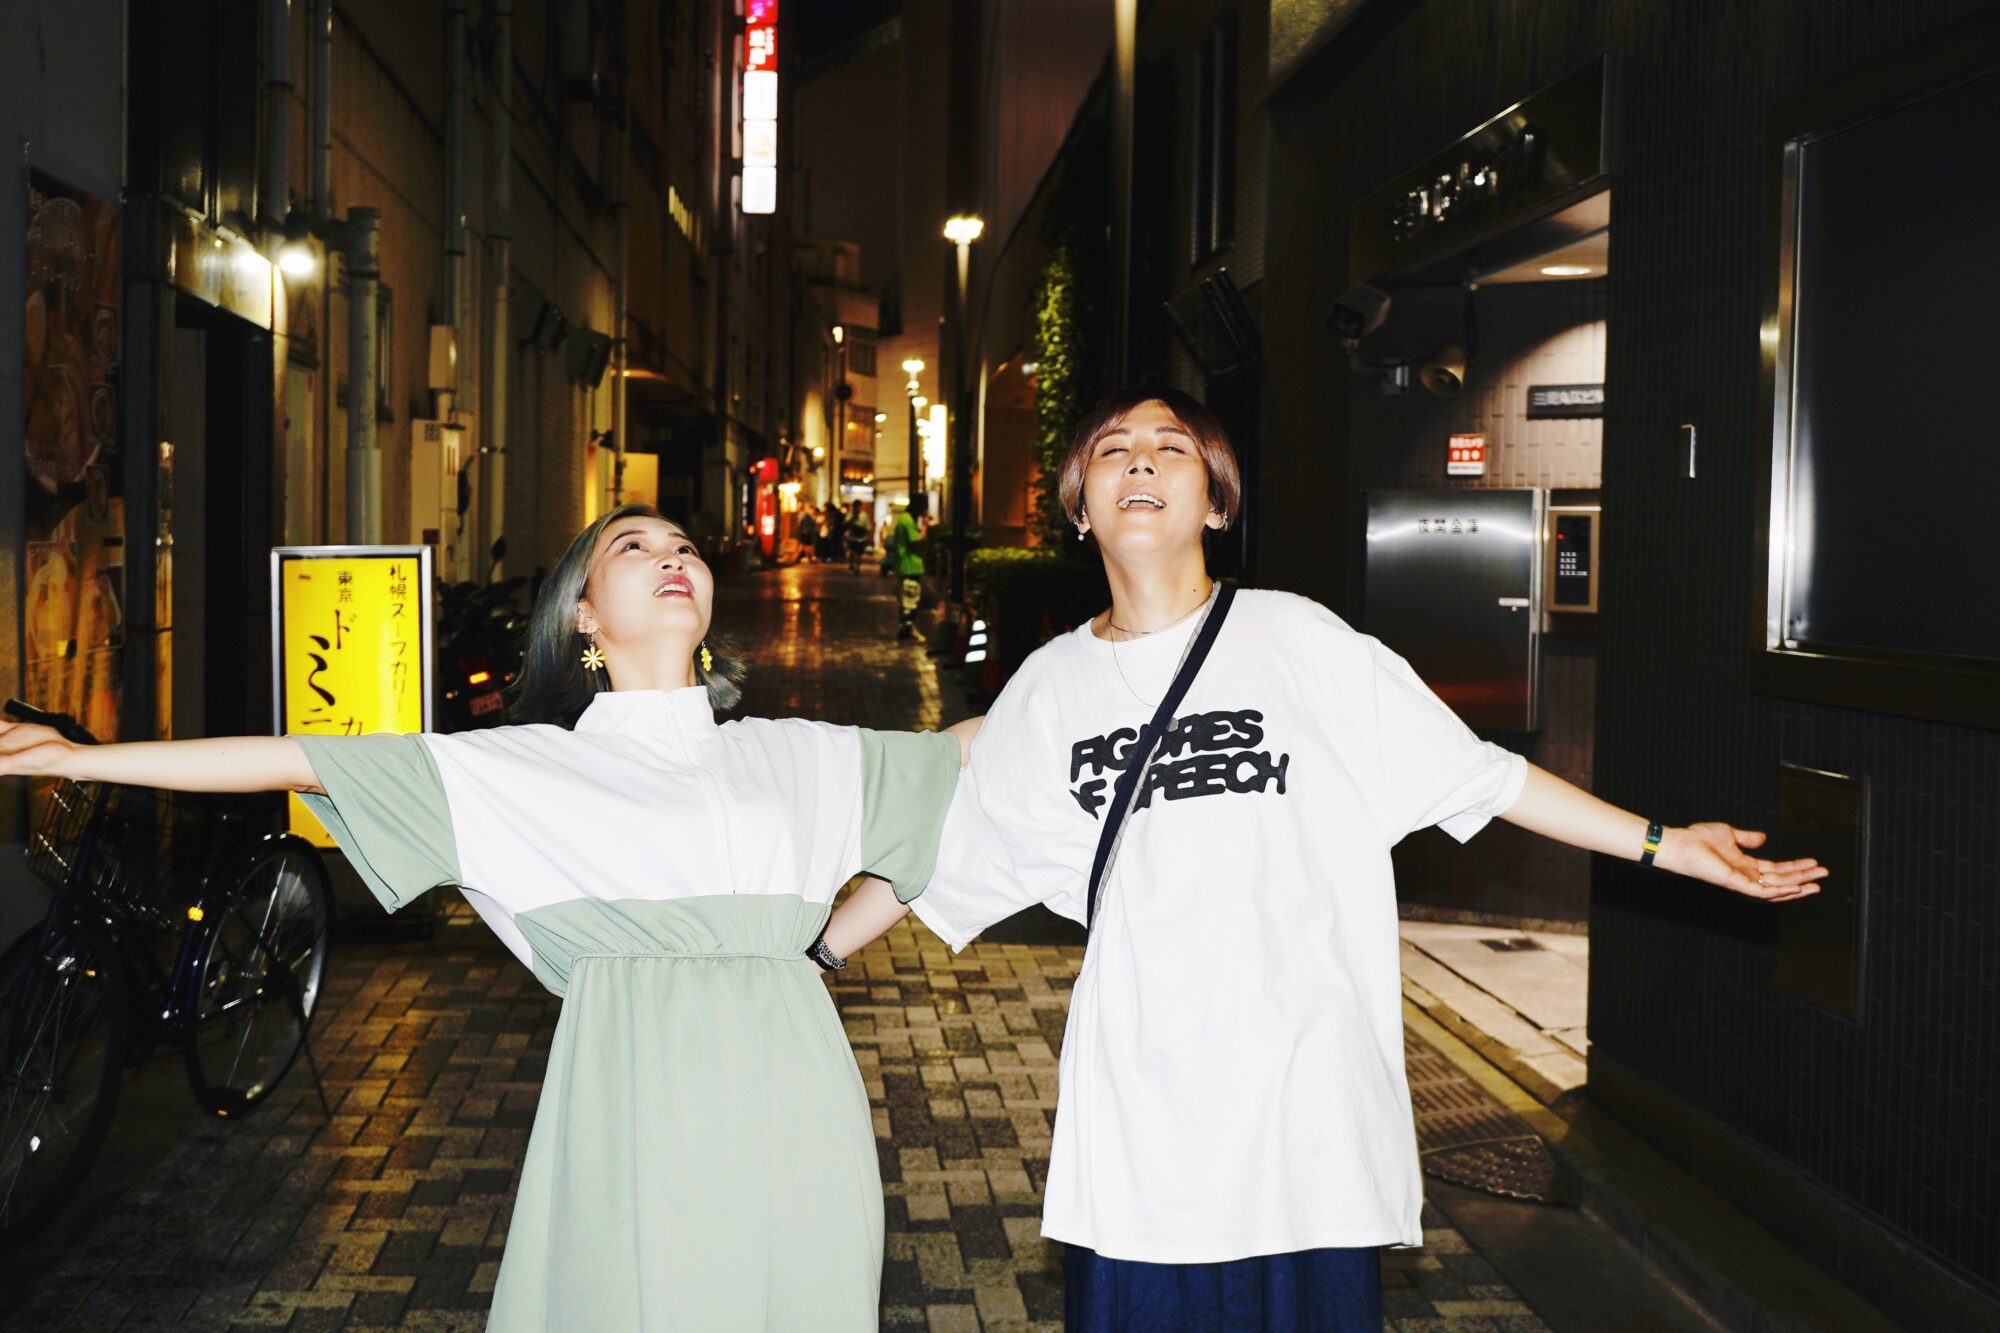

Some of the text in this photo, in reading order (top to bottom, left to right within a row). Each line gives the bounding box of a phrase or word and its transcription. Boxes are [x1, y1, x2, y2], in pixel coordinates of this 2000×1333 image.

[1417, 518, 1479, 534] 夜間金庫
[1069, 751, 1290, 820] F PEECH
